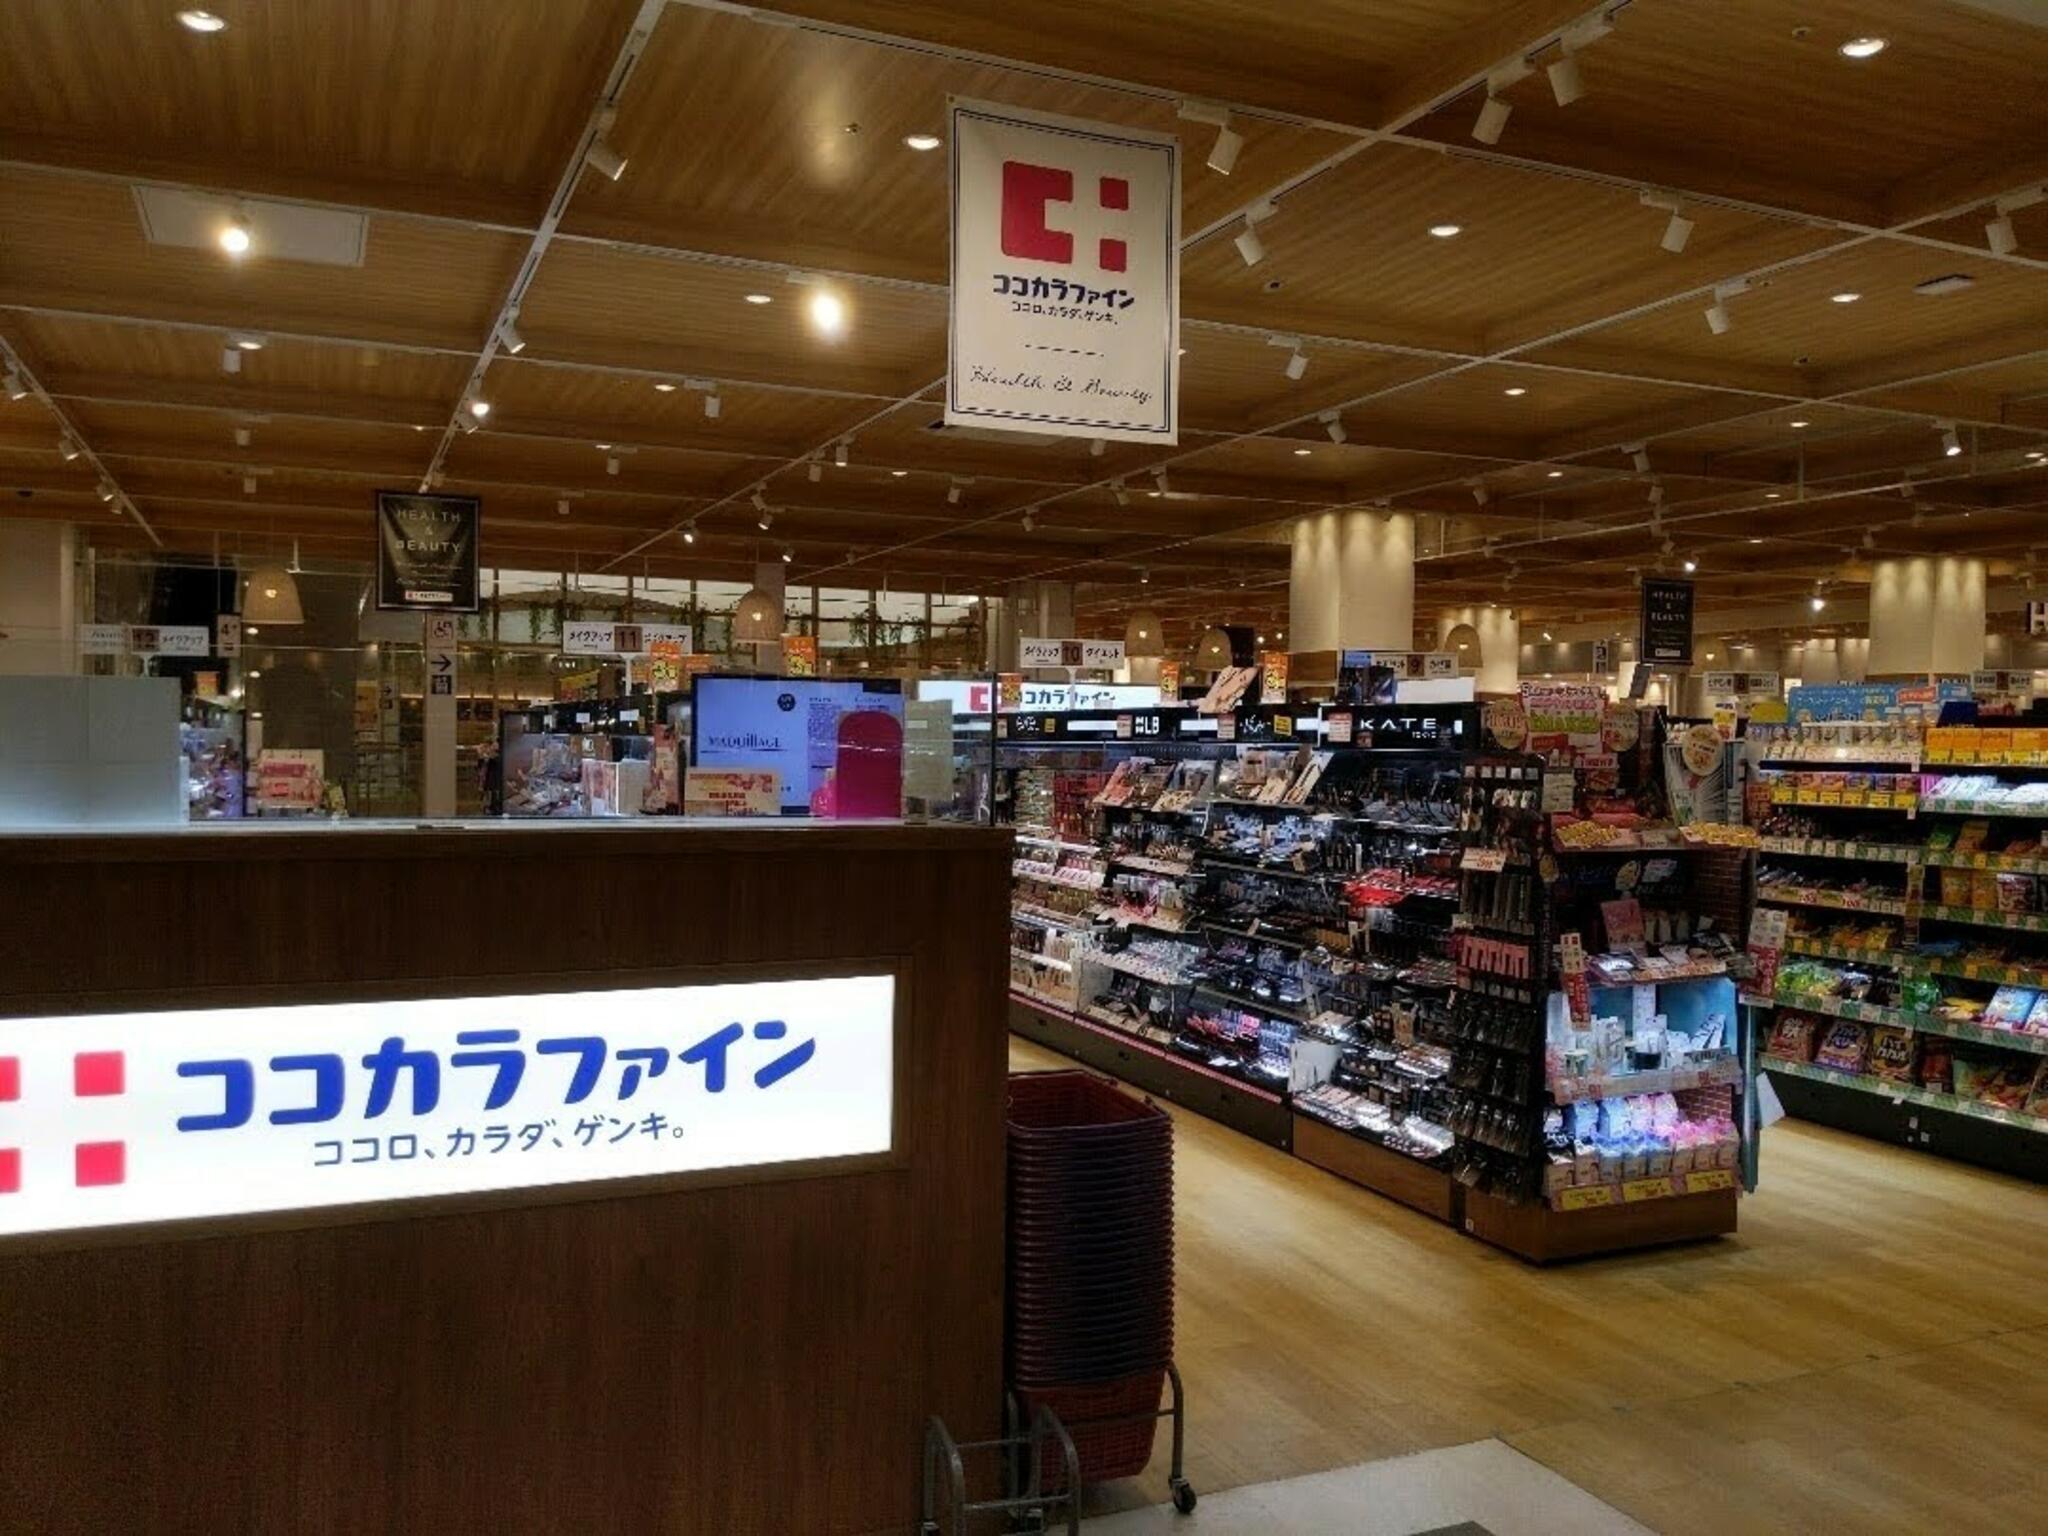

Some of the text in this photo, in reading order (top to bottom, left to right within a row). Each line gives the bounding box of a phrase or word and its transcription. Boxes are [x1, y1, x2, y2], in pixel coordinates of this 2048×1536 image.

[993, 274, 1135, 309] ココカラファイン
[396, 508, 461, 522] HEALTH
[395, 539, 462, 553] BEAUTY
[619, 626, 639, 651] 11
[1061, 644, 1081, 664] 10
[1360, 717, 1438, 730] KATE
[176, 1019, 817, 1132] ココカラファイン
[312, 1113, 687, 1168] ココロ、カラダ、ゲンキ。
